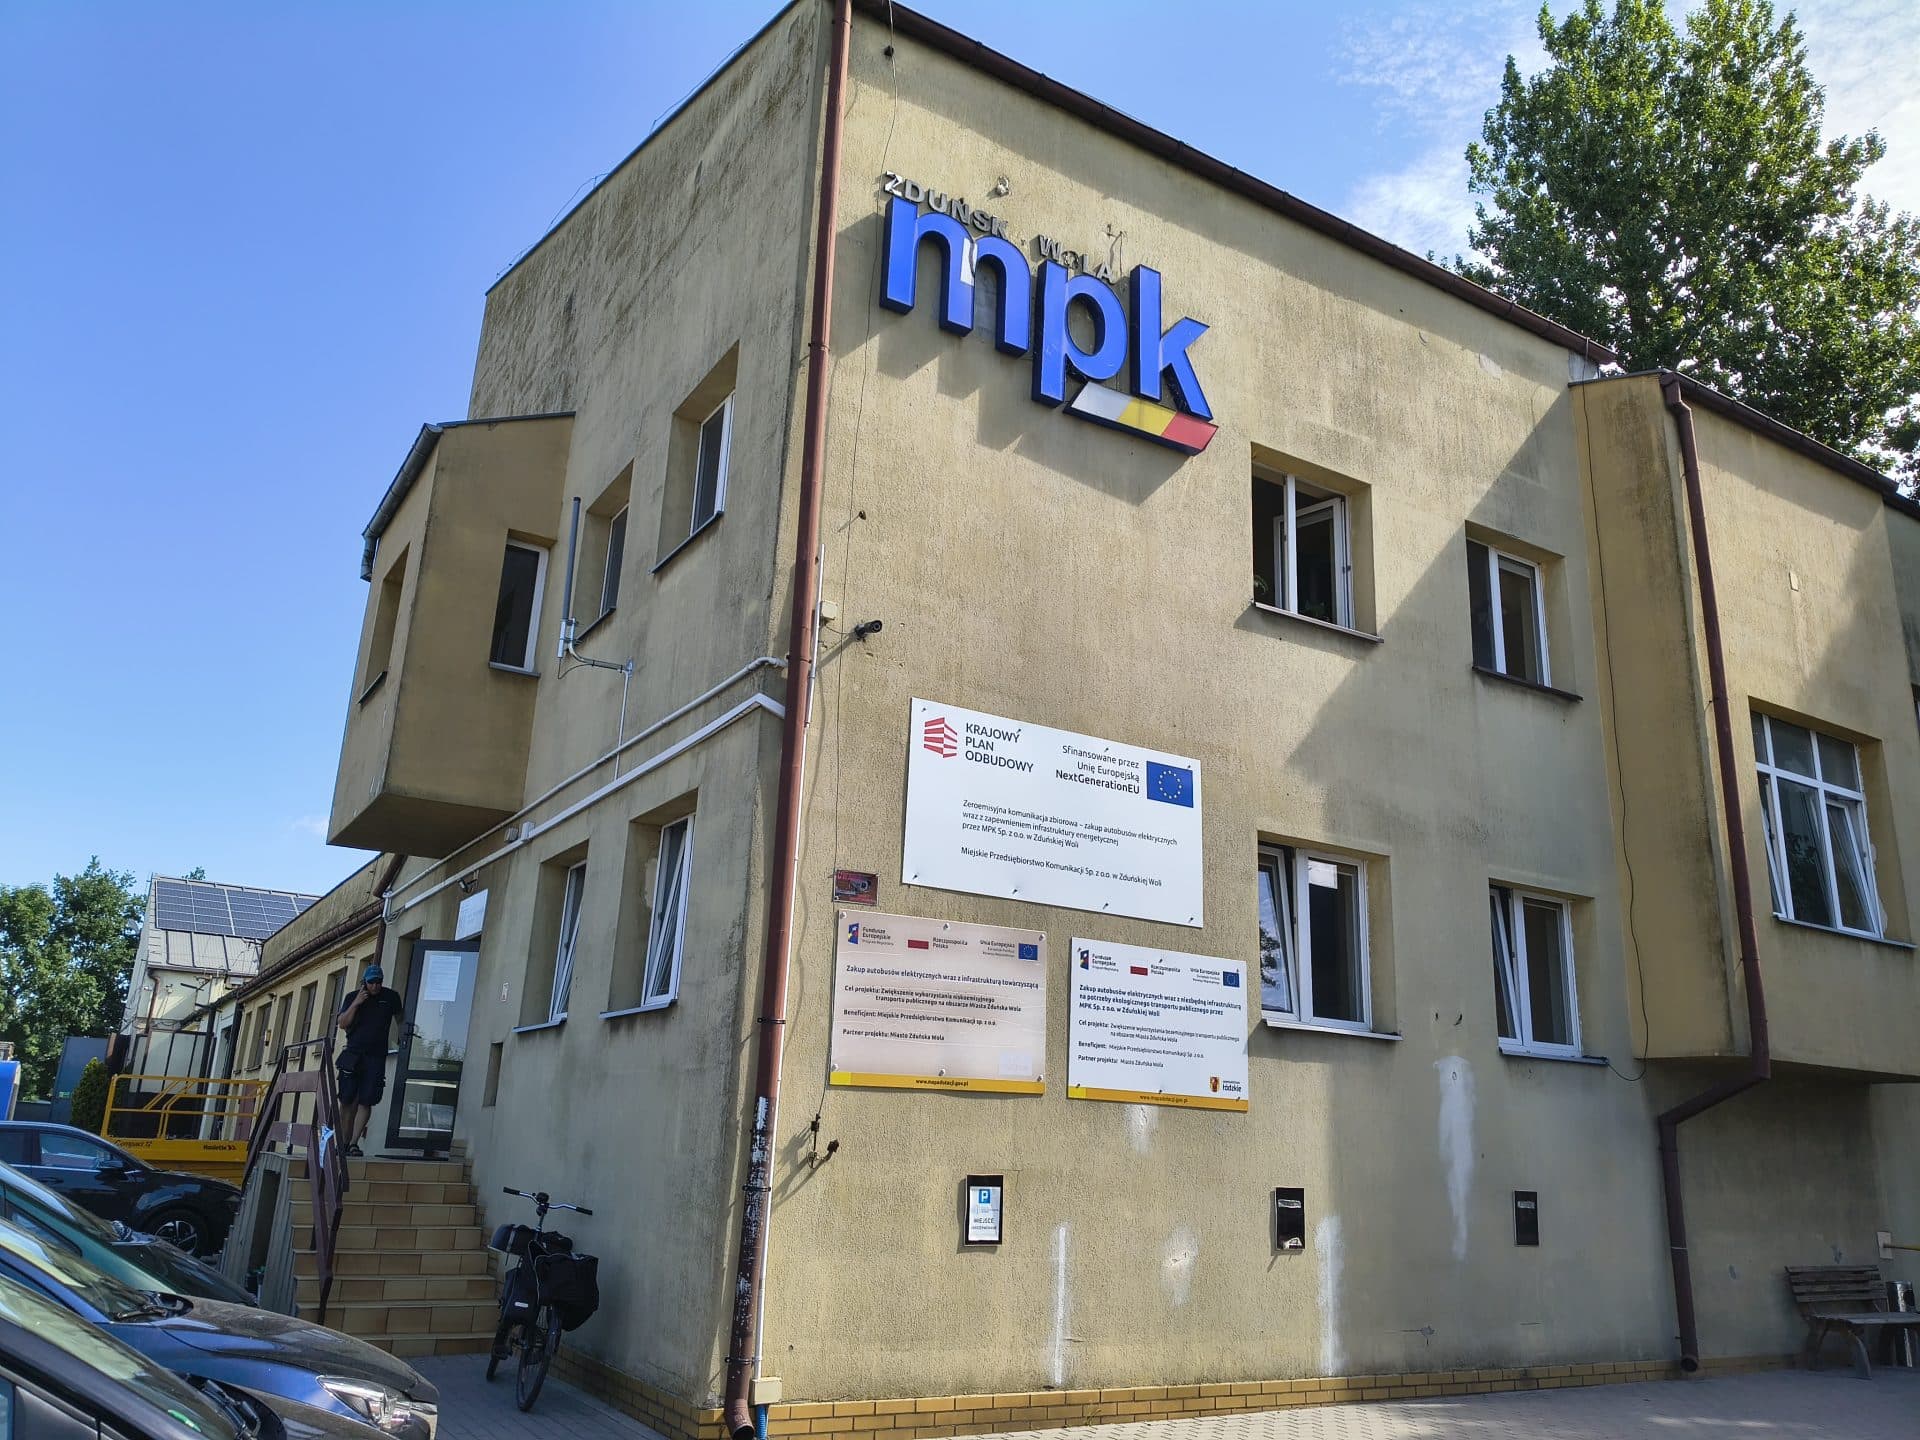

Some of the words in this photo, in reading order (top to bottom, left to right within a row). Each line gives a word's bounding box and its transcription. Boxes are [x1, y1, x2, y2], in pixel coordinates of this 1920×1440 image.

[880, 196, 1213, 422] mpk
[966, 723, 1021, 743] KRAJOWY
[965, 736, 994, 752] PLAN
[965, 750, 1034, 773] ODBUDOWY
[1062, 745, 1117, 764] Sfinansowane
[1118, 758, 1139, 769] przez
[1055, 769, 1140, 795] NextGenerationEU
[1077, 761, 1096, 774] Unię
[1097, 765, 1140, 783] Europejską
[962, 811, 979, 821] wraz
[984, 815, 1031, 830] zapewnieniem
[1032, 822, 1075, 838] infrastruktury
[1075, 832, 1118, 847] energetycznej
[963, 800, 1007, 814] Zeroemisyjna
[1008, 808, 1049, 823] komunikacja
[1049, 815, 1078, 828] zbiorowa
[1084, 823, 1102, 833] zakup
[1103, 826, 1137, 839] autobusów
[1138, 831, 1178, 846] elektrycznych
[962, 821, 980, 832] przez
[981, 824, 997, 834] MPK
[997, 828, 1007, 837] Sp.
[1033, 834, 1064, 848] Zduńskiej
[1065, 840, 1079, 848] Woli
[961, 846, 989, 859] Miejskie
[989, 851, 1044, 868] Przedsiębiorstwo
[1045, 861, 1084, 875] Komunikacji
[1085, 867, 1094, 877] Sp.
[1119, 873, 1148, 886] Zduńskiej
[1148, 878, 1162, 887] Woli
[862, 926, 886, 934] Fundusze
[862, 932, 891, 941] Europejskie
[933, 937, 968, 946] Rzeczpospolita
[846, 965, 866, 973] Zakup
[866, 966, 900, 977] autobusów
[900, 970, 942, 981] elektrycznych
[961, 974, 1002, 987] infrastrukturą
[1002, 980, 1039, 990] towarzyszącą
[855, 986, 880, 994] projektu:
[881, 988, 914, 997] Zwiększenie
[914, 992, 952, 1001] wykorzystania
[953, 993, 995, 1003] niskoemisyjnego
[875, 996, 905, 1004] transportu
[906, 998, 938, 1006] publicznego
[987, 1004, 1008, 1012] Zduńska
[1079, 984, 1096, 993] Zakup
[1097, 987, 1127, 996] autobusów
[1127, 990, 1164, 1001] elektrycznych
[1180, 996, 1206, 1007] niezbędną
[1206, 999, 1242, 1011] infrastrukturą
[1087, 994, 1112, 1003] potrzeby
[1112, 996, 1150, 1008] ekologicznego
[1150, 1002, 1178, 1011] transportu
[1179, 1004, 1209, 1015] publicznego
[1209, 1008, 1223, 1016] przez
[843, 1009, 876, 1018] Beneficjent:
[877, 1011, 899, 1019] Miejskie
[900, 1013, 945, 1023] Przedsiębiorstwo
[945, 1016, 976, 1024] Komunikacji
[1121, 1007, 1148, 1017] Zduńskiej
[842, 1028, 864, 1036] Partner
[864, 1029, 889, 1038] projektu:
[890, 1031, 908, 1039] Miasto
[908, 1033, 931, 1041] Zduńska
[1078, 1041, 1107, 1050] Beneficjent:
[1078, 1054, 1096, 1062] Partner
